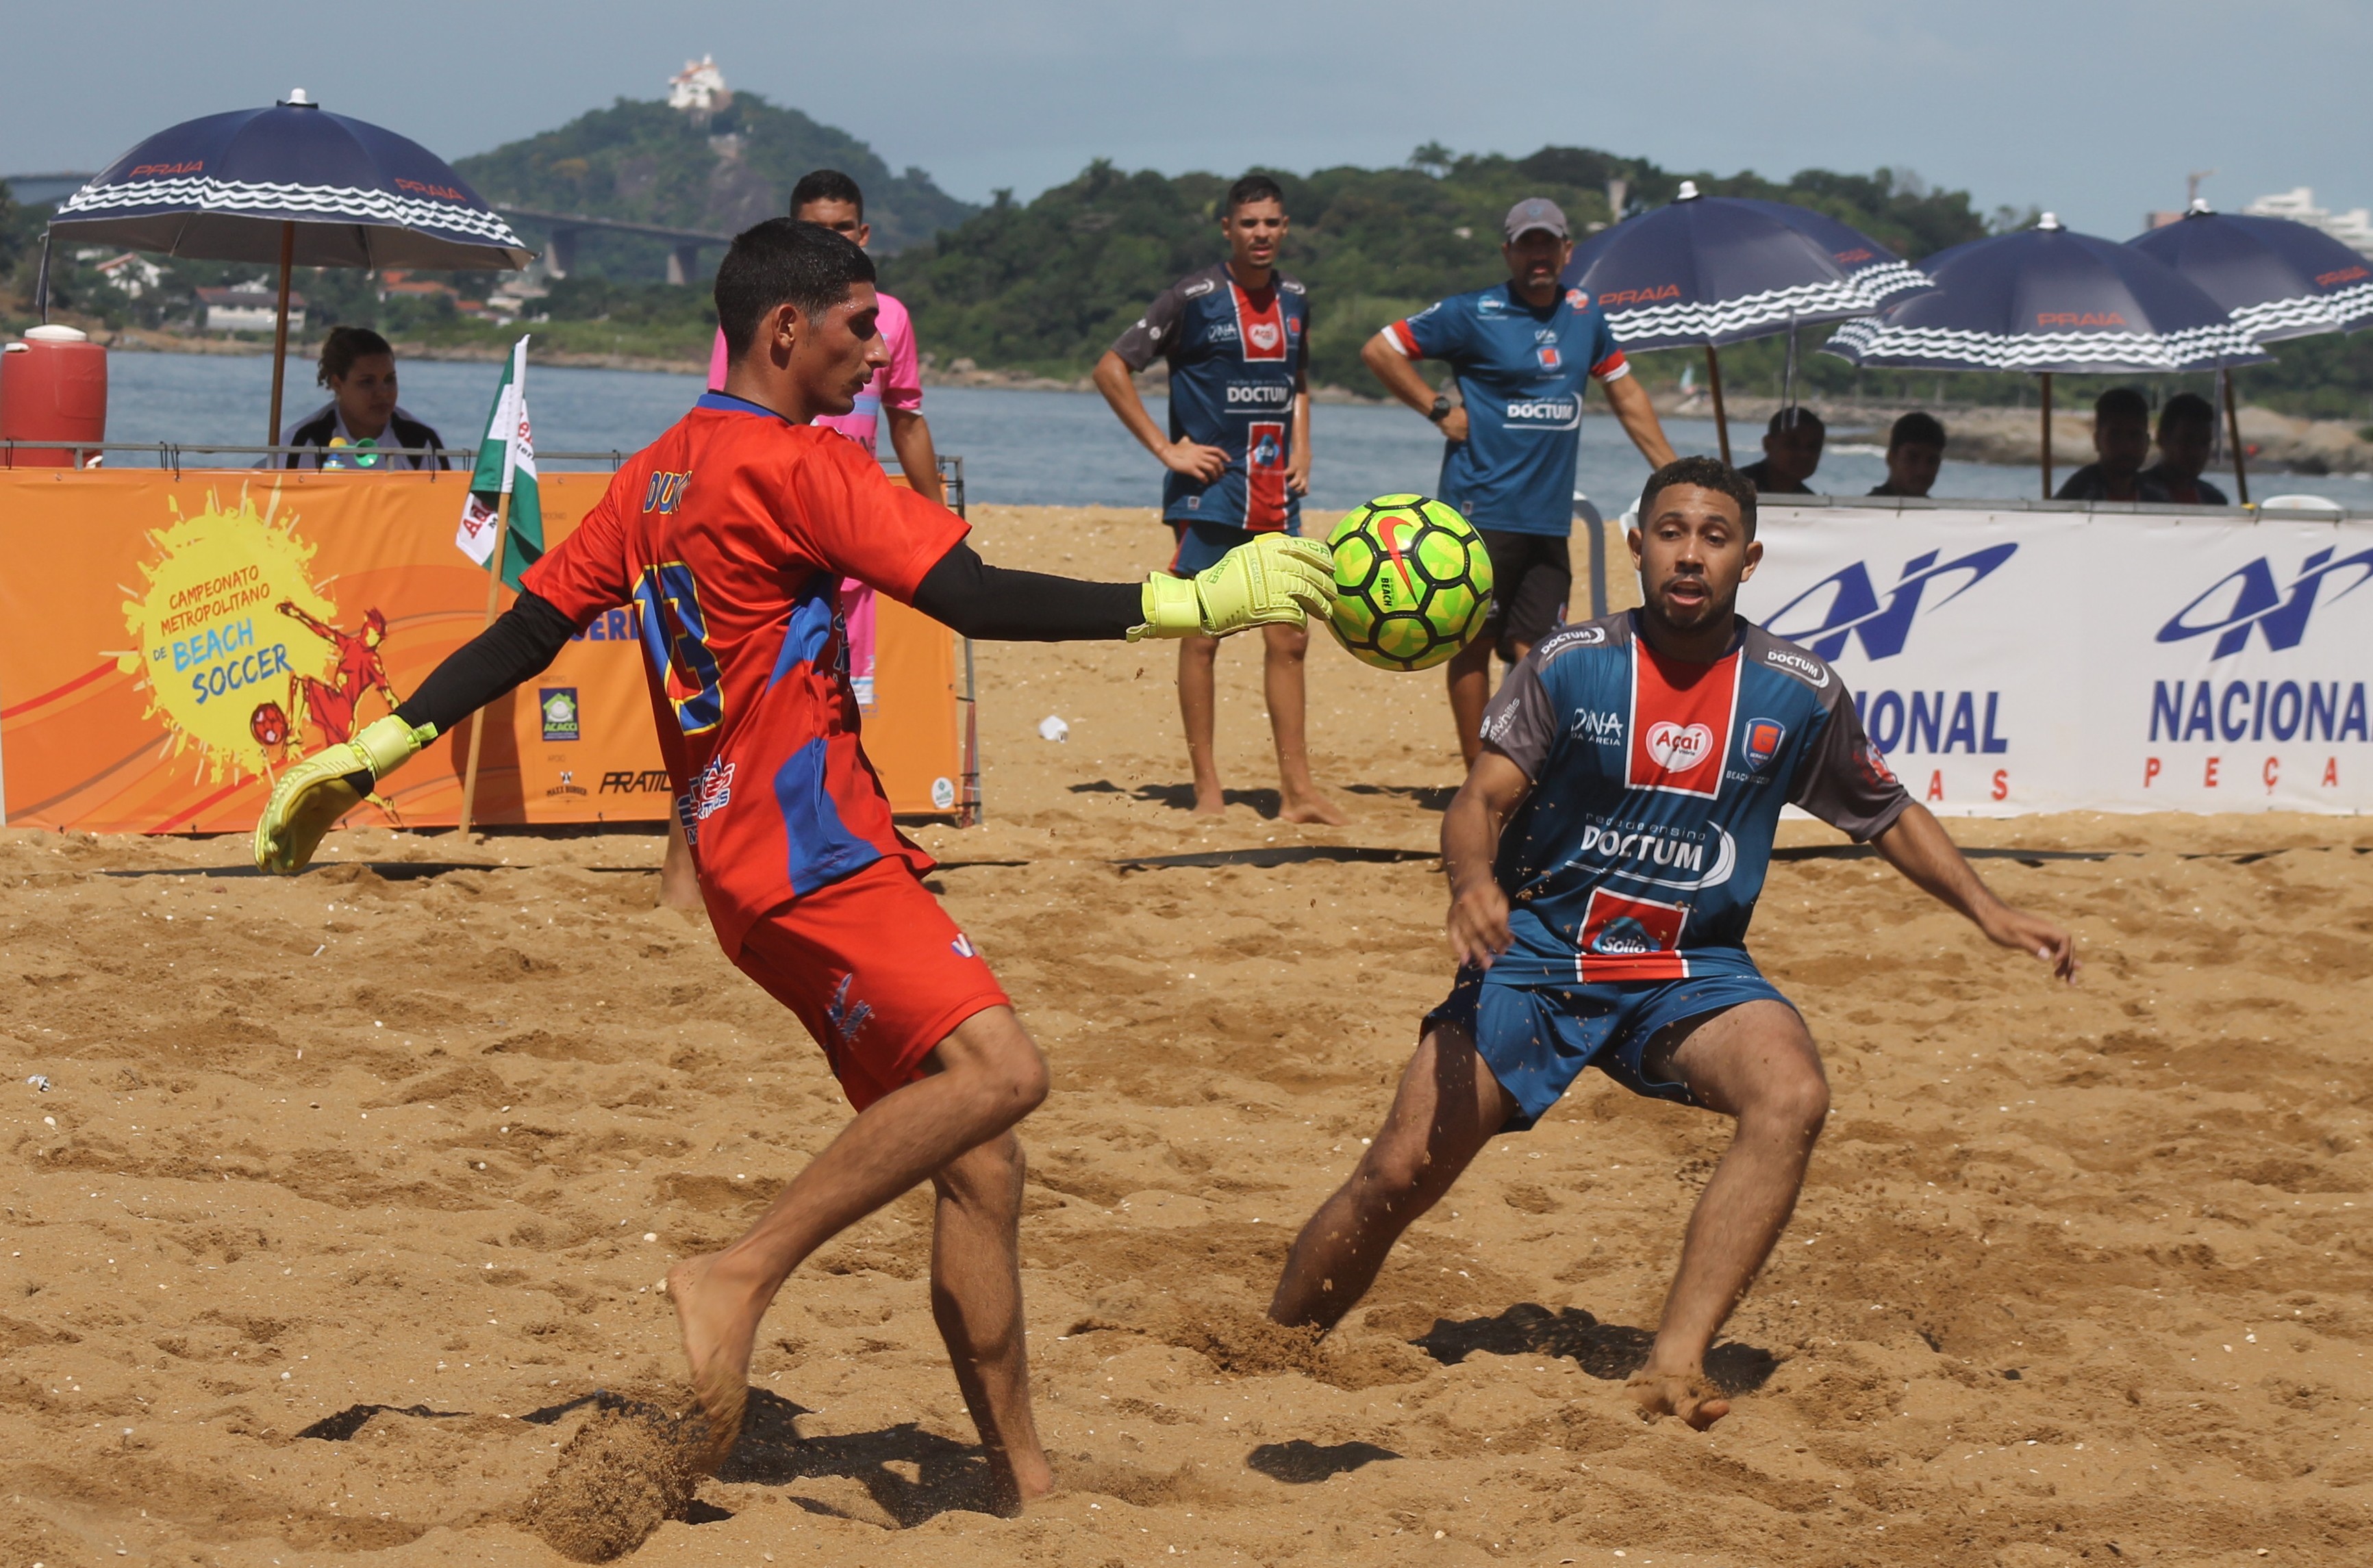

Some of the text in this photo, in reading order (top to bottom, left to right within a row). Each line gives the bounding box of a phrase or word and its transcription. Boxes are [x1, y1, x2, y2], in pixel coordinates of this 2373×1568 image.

[129, 160, 203, 178] PRAIA
[394, 178, 467, 202] PRAIA
[1598, 283, 1681, 306] PRAIA
[2037, 311, 2127, 328] PRAIA
[1227, 386, 1288, 403] DOCTUM
[1507, 404, 1574, 420] DOCTUM
[169, 565, 259, 610] CAMPEONATO
[1381, 577, 1392, 606] BEACH
[161, 583, 270, 637] METROPOLITANO
[153, 617, 253, 672] DE BEACH
[1541, 629, 1592, 655] DOCTUM
[192, 643, 294, 705] SOCCER
[1768, 650, 1819, 678] DOCTUM
[1588, 734, 1621, 746] AREIA
[1656, 730, 1702, 752] Açaí
[1581, 825, 1703, 872] DOCTUM
